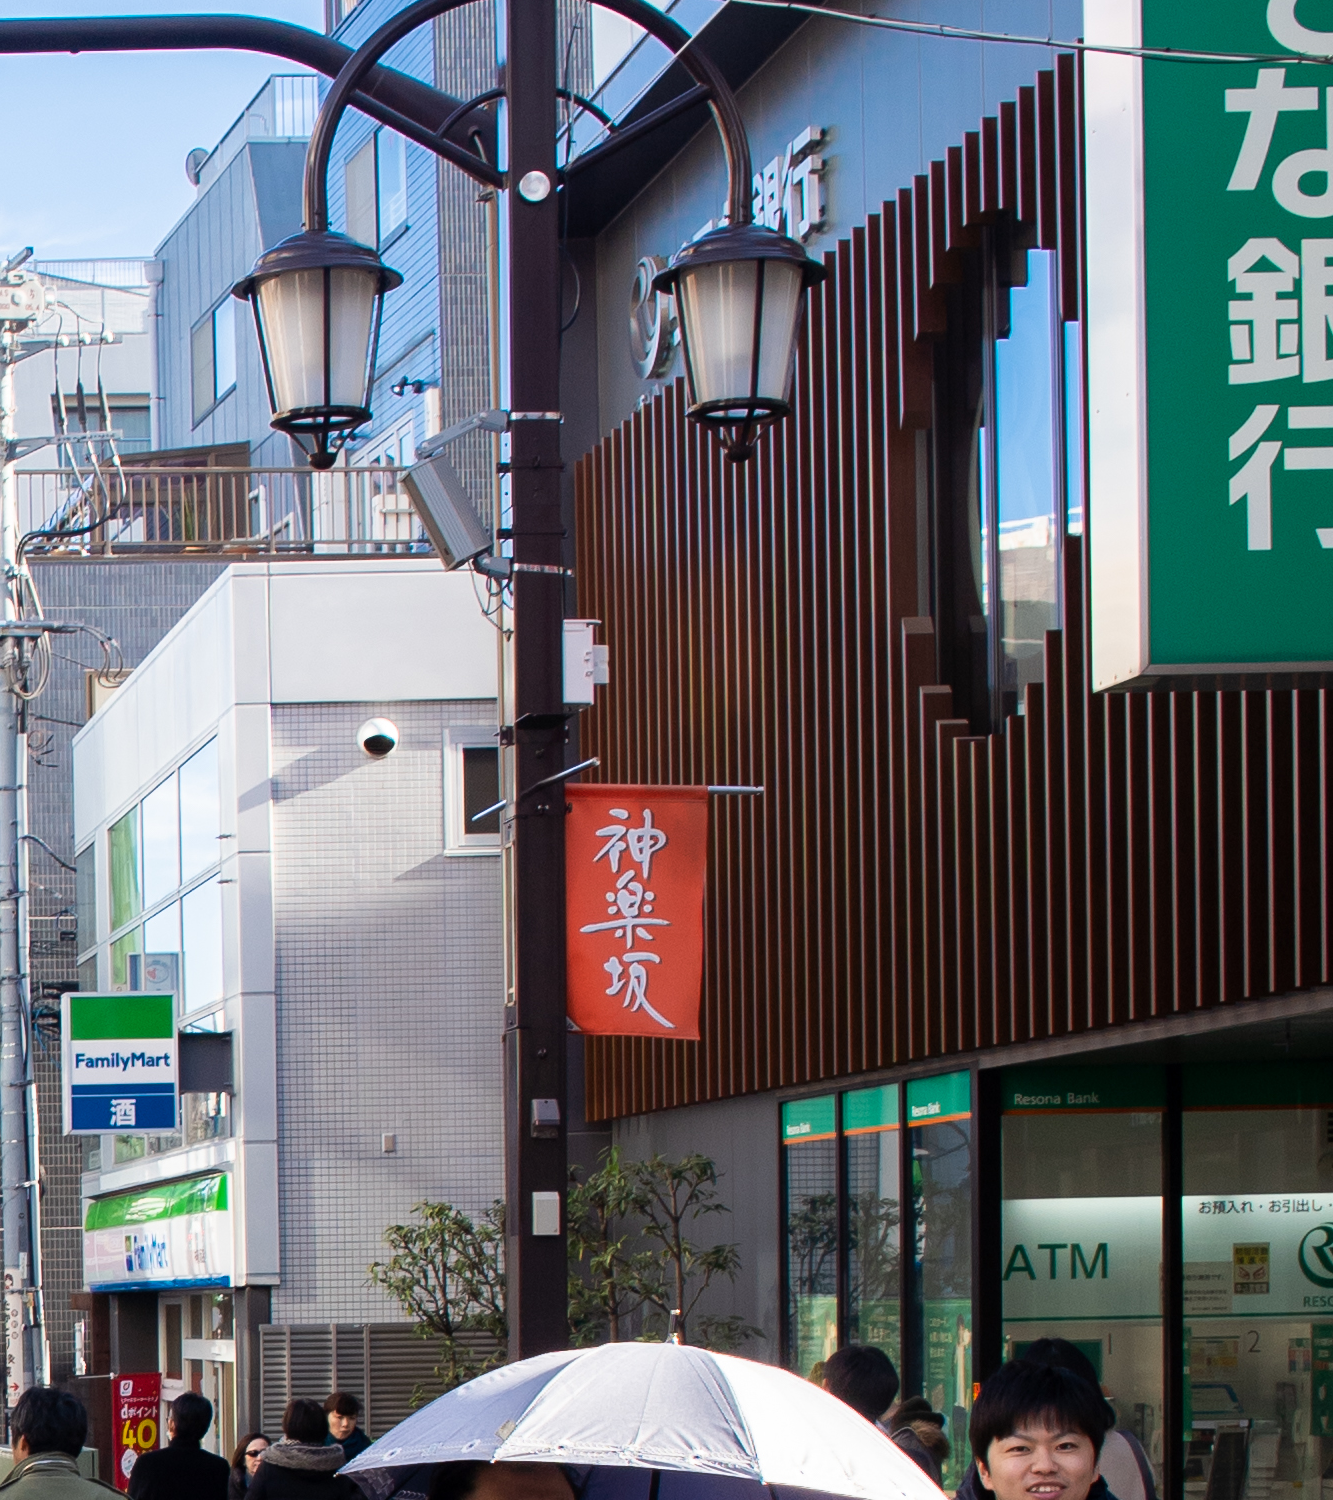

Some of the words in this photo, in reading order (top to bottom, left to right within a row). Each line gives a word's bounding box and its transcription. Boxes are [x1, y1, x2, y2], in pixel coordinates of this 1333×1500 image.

[579, 807, 678, 1029] 神楽坂
[75, 1052, 171, 1072] FamilyMart
[109, 1098, 137, 1127] 酒
[1013, 1092, 1061, 1106] Resona
[1067, 1091, 1100, 1105] Bank
[1002, 1242, 1109, 1281] ATM
[120, 1403, 158, 1420] dポイント
[121, 1418, 157, 1449] 40
